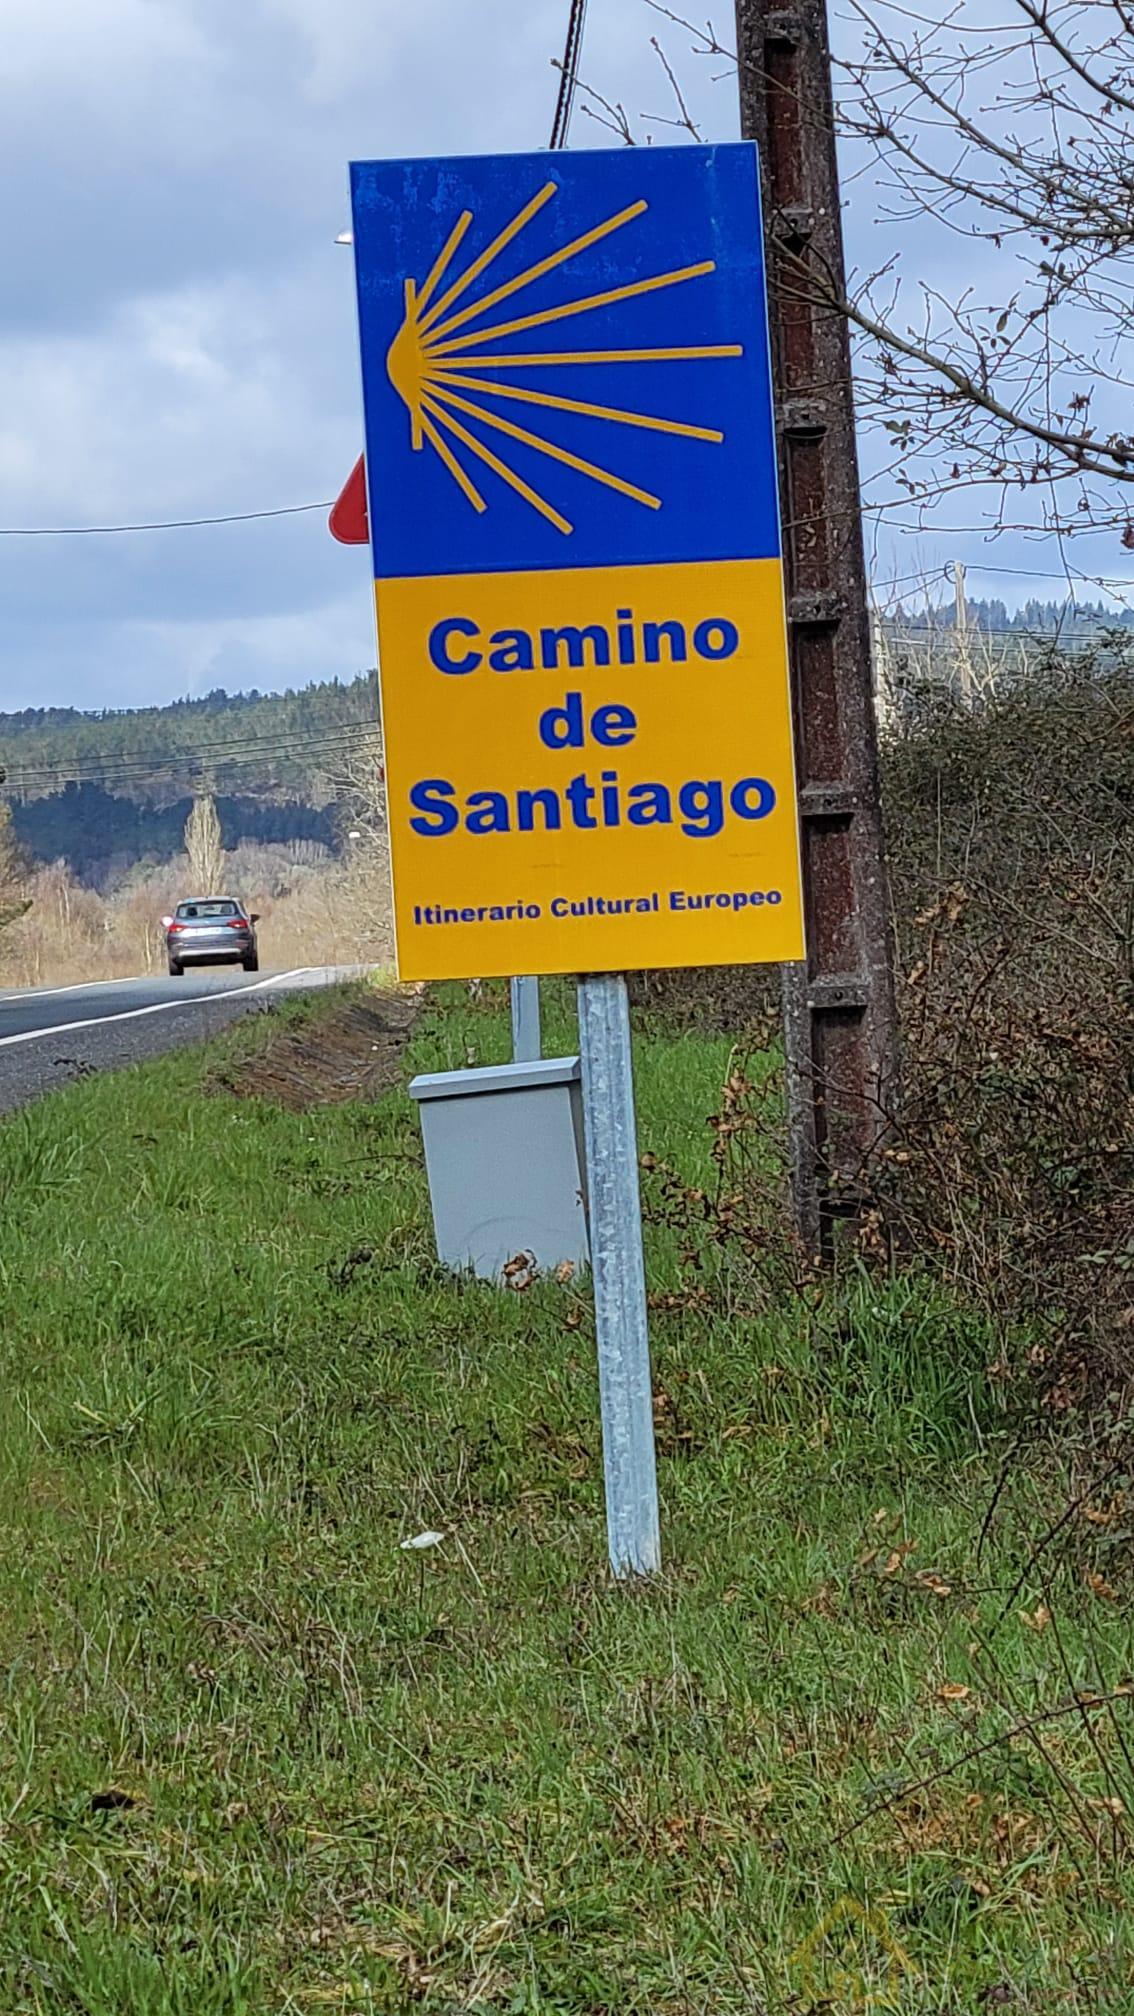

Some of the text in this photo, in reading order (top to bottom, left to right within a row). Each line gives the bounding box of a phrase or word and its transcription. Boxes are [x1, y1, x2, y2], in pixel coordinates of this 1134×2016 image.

[428, 608, 740, 676] Camino
[539, 691, 637, 750] de
[409, 770, 777, 838] Santiago
[413, 891, 783, 926] Itinerario Cultural Europeo
